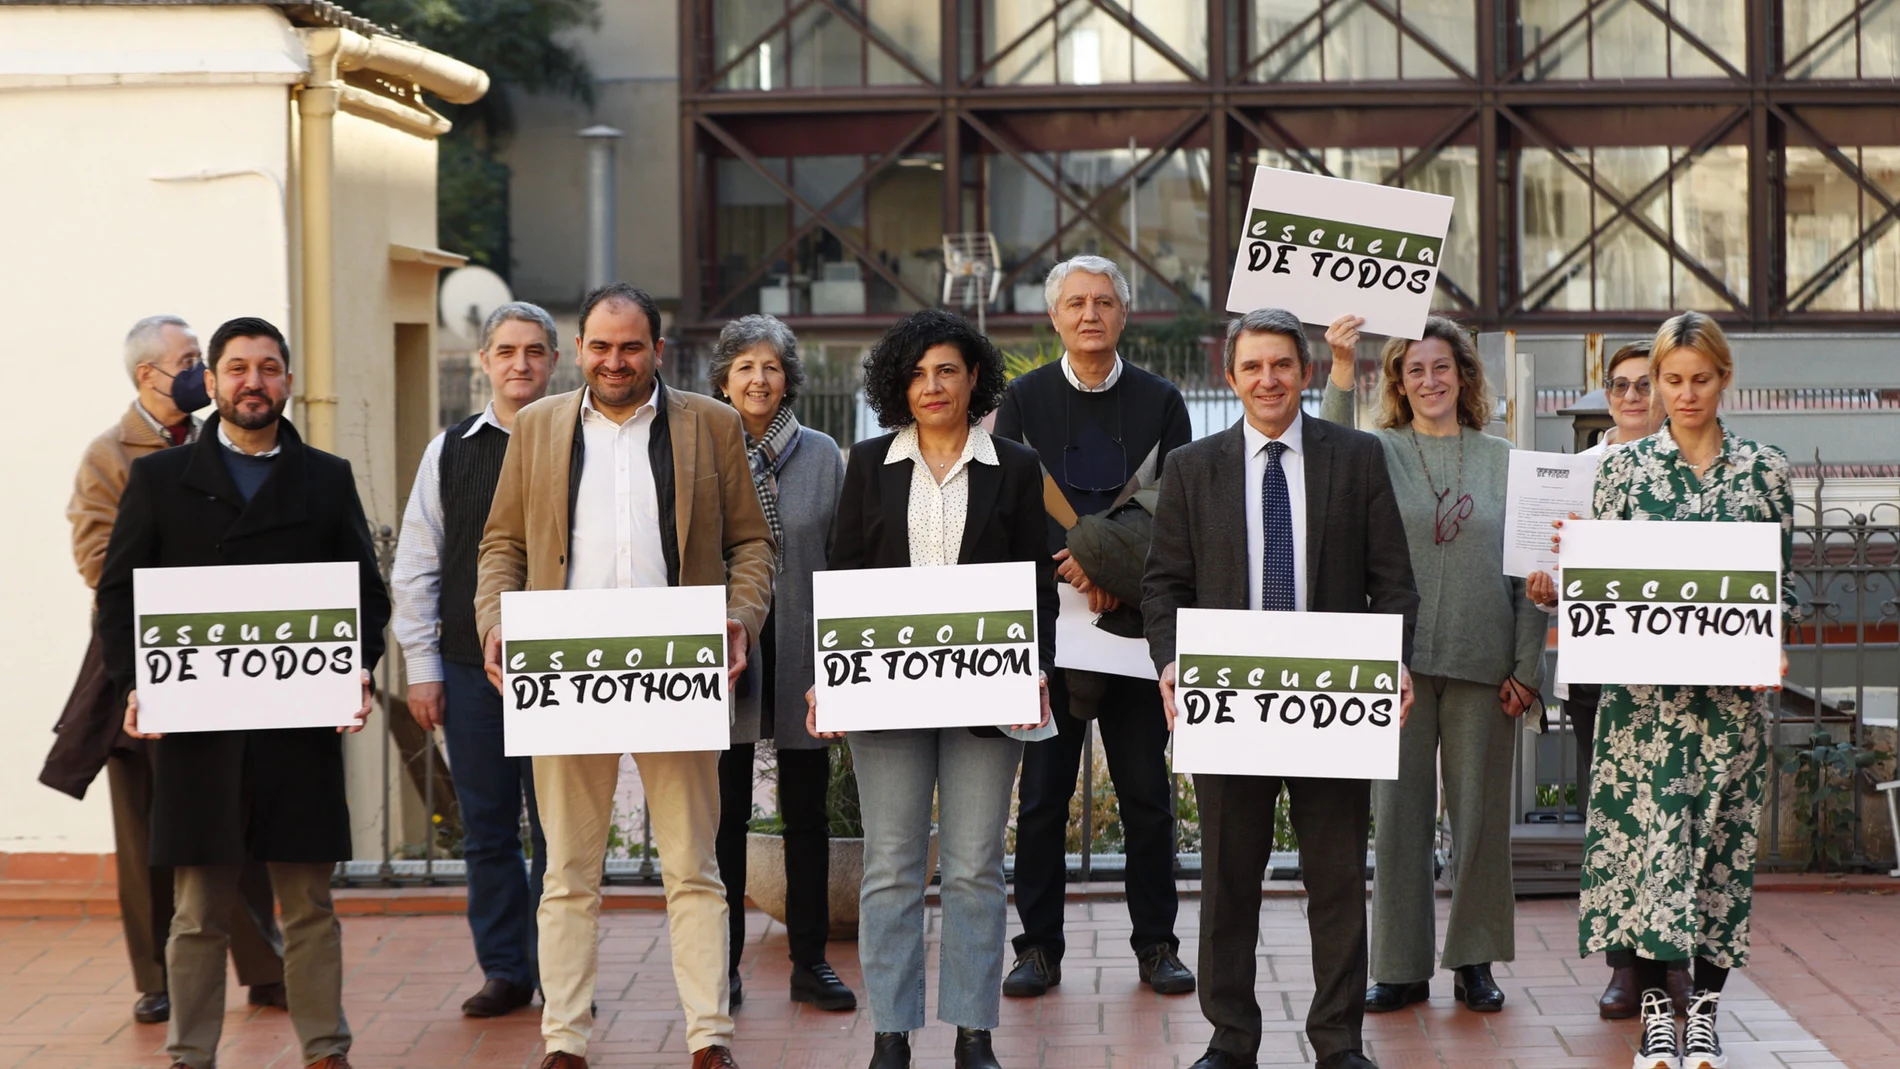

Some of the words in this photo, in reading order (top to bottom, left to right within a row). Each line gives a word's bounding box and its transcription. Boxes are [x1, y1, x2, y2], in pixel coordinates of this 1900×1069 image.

[1251, 220, 1435, 264] escuela
[1247, 241, 1297, 275] DE
[1311, 252, 1430, 294] TODOS
[1566, 575, 1770, 600] escola
[142, 614, 353, 645] escuela
[821, 617, 1026, 648] escola
[1568, 603, 1617, 638] DE
[1625, 604, 1774, 638] TOTHOM
[145, 648, 199, 684] DE
[216, 645, 353, 680] TODOS
[510, 640, 716, 670] escola
[823, 651, 873, 687] DE
[881, 647, 1032, 680] TOTHOM
[511, 674, 561, 710] DE
[569, 672, 722, 704] TOTHOM
[1182, 664, 1394, 691] escuela
[1183, 689, 1238, 725] DE
[1254, 692, 1393, 729] TODOS
